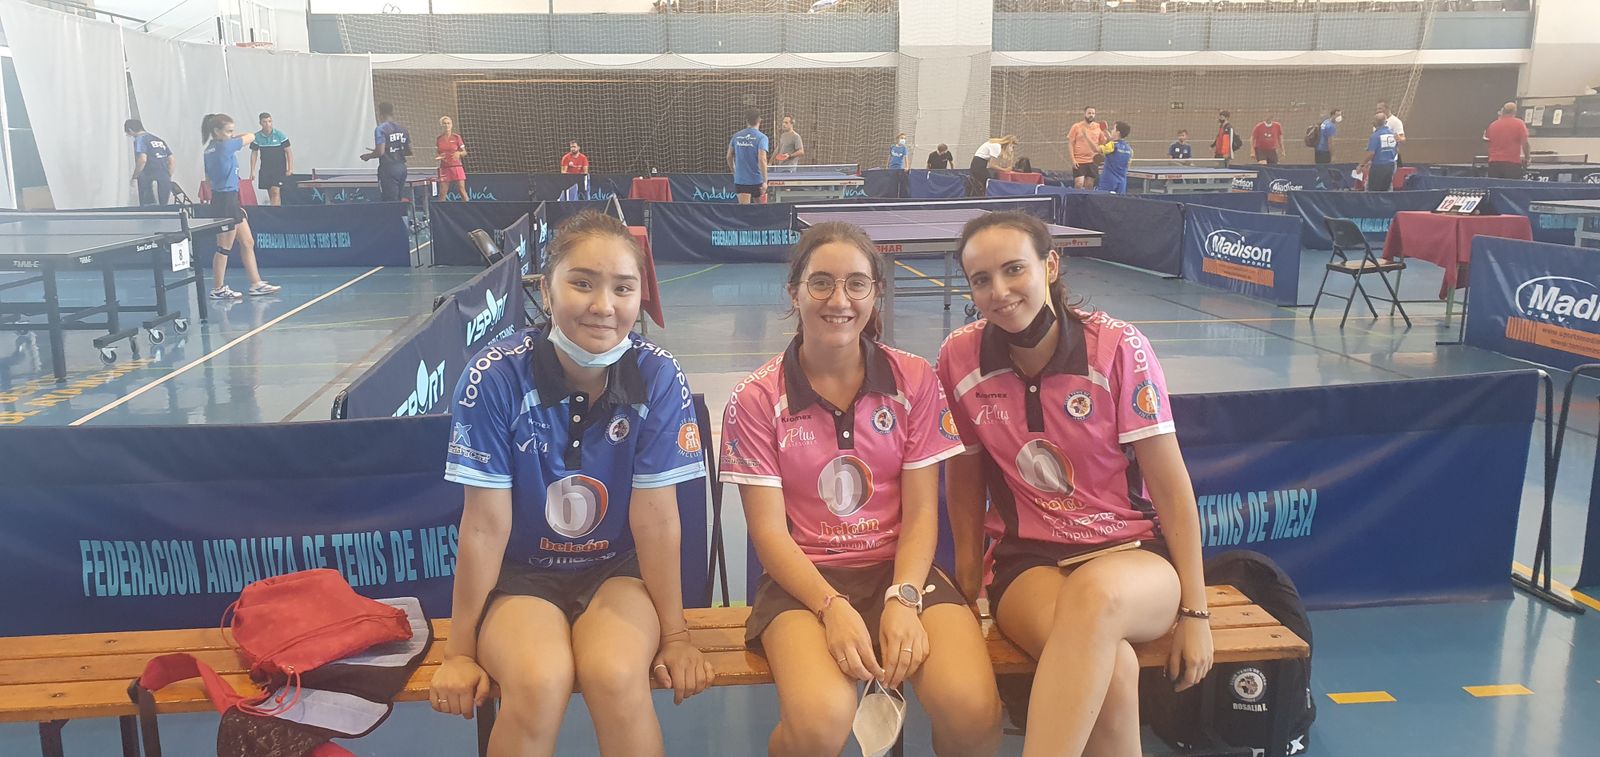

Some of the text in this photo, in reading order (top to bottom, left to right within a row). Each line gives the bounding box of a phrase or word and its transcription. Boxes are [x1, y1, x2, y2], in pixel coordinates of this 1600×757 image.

[1440, 199, 1477, 211] 12 10
[1212, 234, 1273, 263] Madison
[781, 414, 812, 423] Kromex
[786, 426, 816, 442] Plus
[1198, 487, 1318, 547] TENIS DE MESA
[820, 517, 880, 537] belcón
[540, 536, 609, 553] belcón
[79, 540, 202, 597] FEDERACION
[202, 536, 298, 594] ANDALUZA
[331, 530, 388, 587] TENIS
[389, 529, 418, 583] DE
[419, 524, 459, 579] MES
